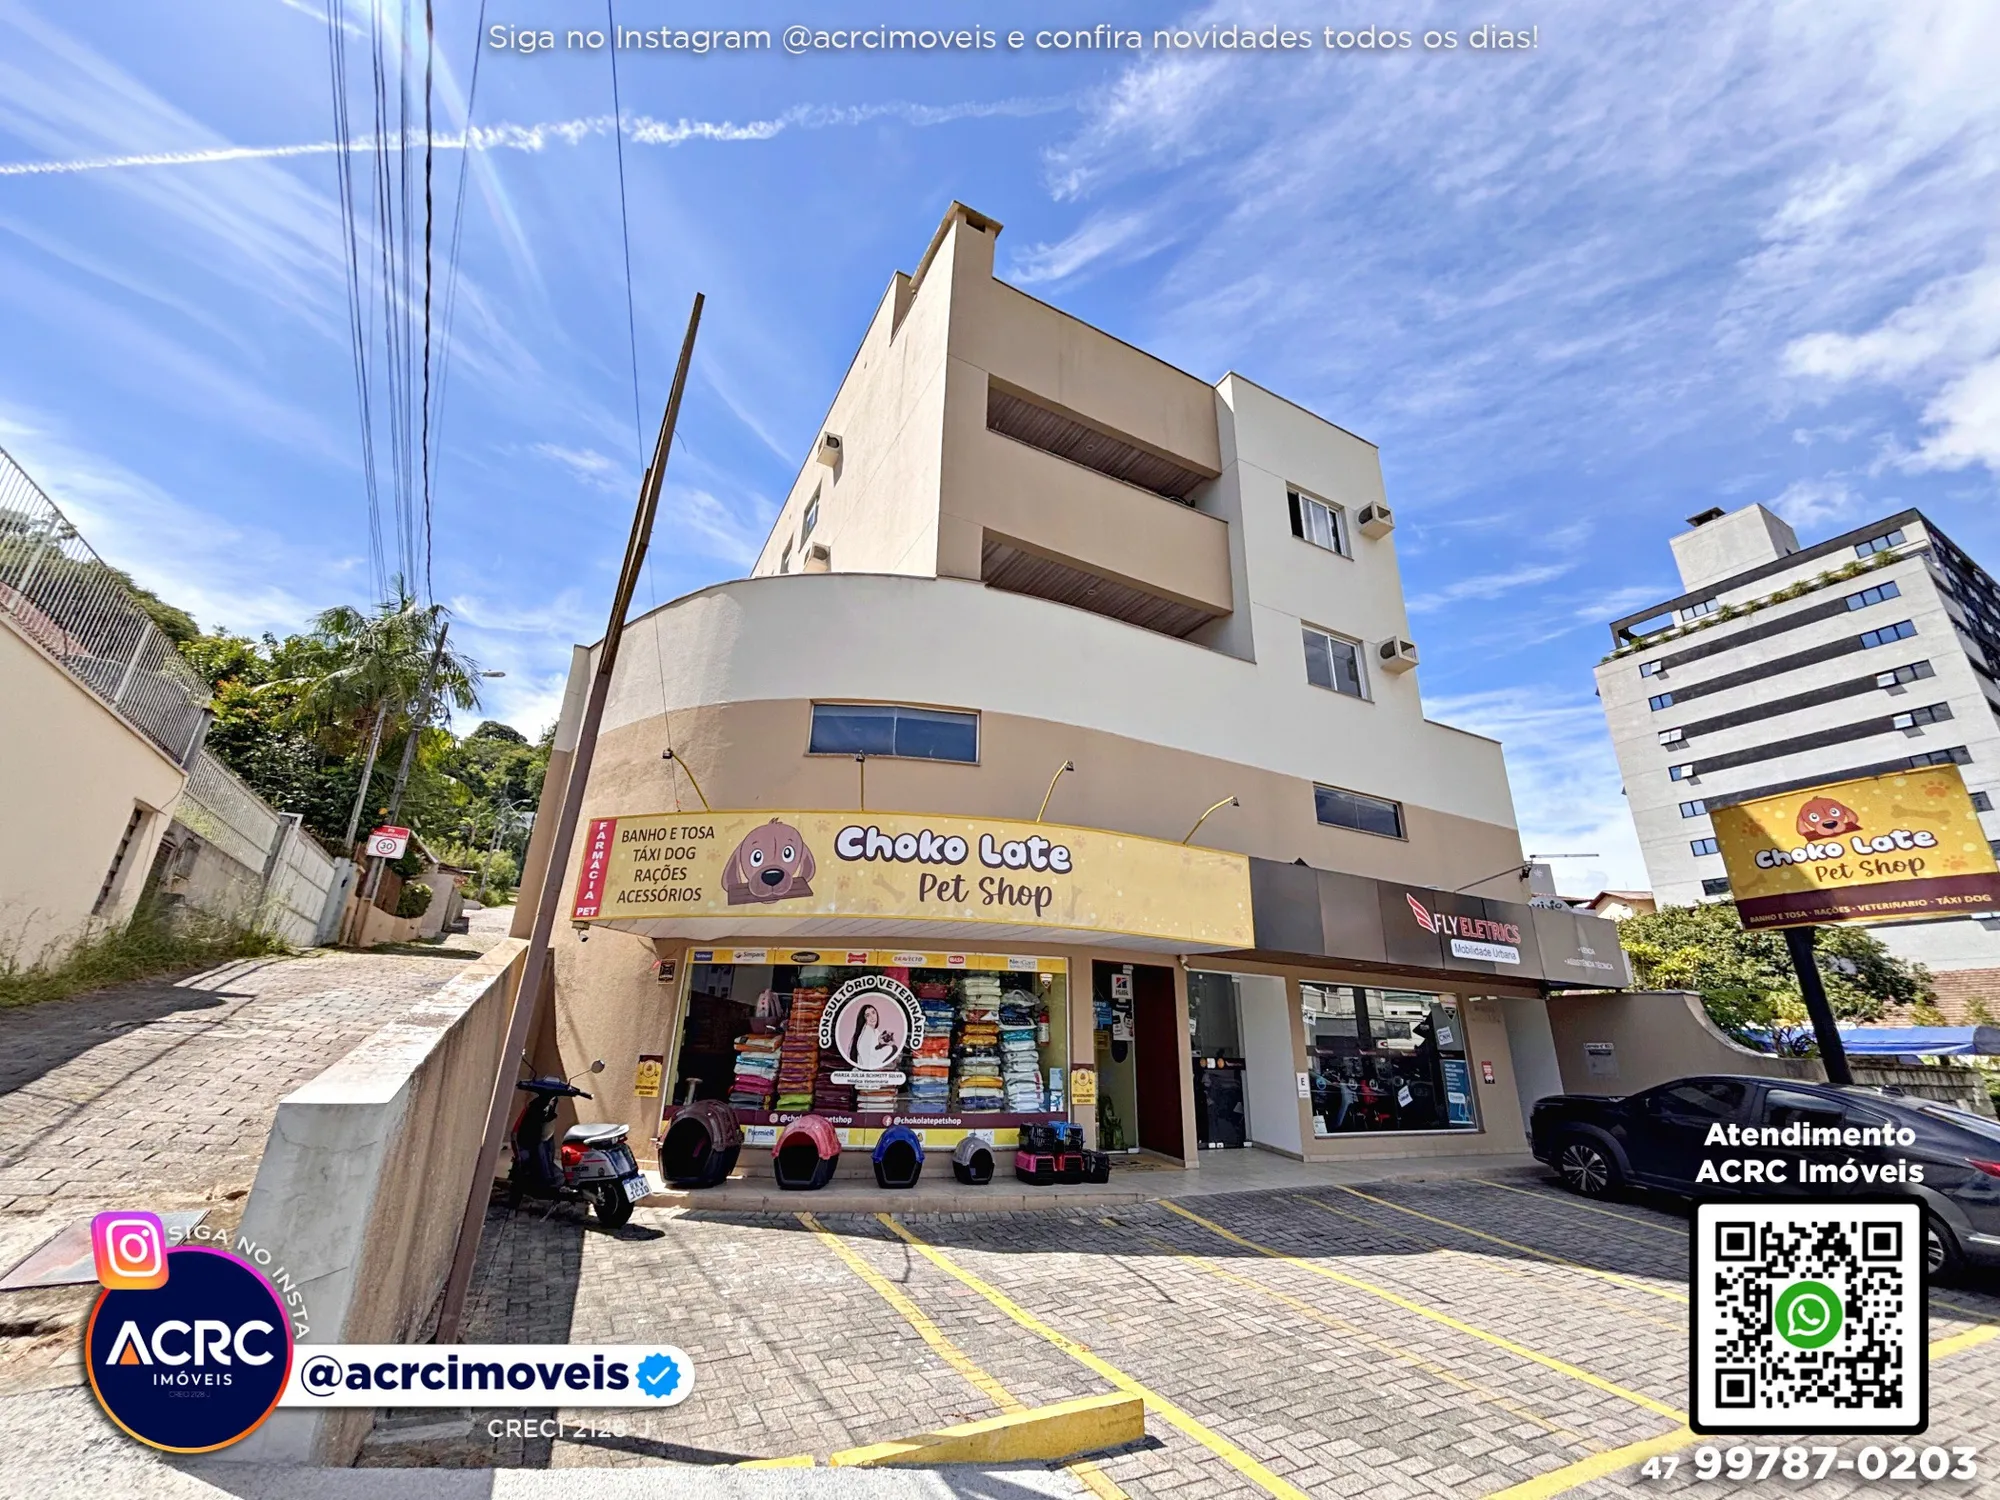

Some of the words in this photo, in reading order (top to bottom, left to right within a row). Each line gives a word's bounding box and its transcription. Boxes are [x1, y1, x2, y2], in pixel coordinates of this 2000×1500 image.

[621, 828, 667, 843] BANHO
[670, 829, 678, 840] E
[681, 826, 715, 840] TOSA
[379, 842, 393, 851] 30
[633, 845, 660, 862] TÁXI
[664, 847, 696, 860] DOG
[834, 825, 969, 865] Choko
[978, 833, 1073, 875] Late
[1755, 841, 1844, 870] Choko
[1850, 828, 1938, 856] Late
[584, 822, 608, 900] FARMÁCIA
[1815, 863, 1854, 883] Pet
[1858, 857, 1925, 877] Shop
[633, 864, 688, 884] RAÇÕES
[616, 885, 702, 904] ACESSÓRIOS
[919, 872, 970, 903] Pet
[978, 876, 1053, 917] Shop
[576, 906, 597, 917] PET
[1750, 914, 1777, 924] BANHO
[1778, 913, 1785, 921] E
[1785, 910, 1808, 919] TOSA
[1814, 905, 1851, 917] RAÇÕES
[1935, 894, 1962, 906] TÁXI
[1964, 893, 1992, 904] DOG
[1433, 913, 1458, 935] FLY
[1459, 916, 1521, 944] ELETRICS
[1454, 943, 1492, 957] Mobilidade
[1492, 948, 1517, 960] Urbana
[820, 977, 876, 1046] CONSULTÓRIO
[878, 977, 923, 1048] VETERINÁRIO
[893, 1116, 962, 1127] @chokolatepetshop
